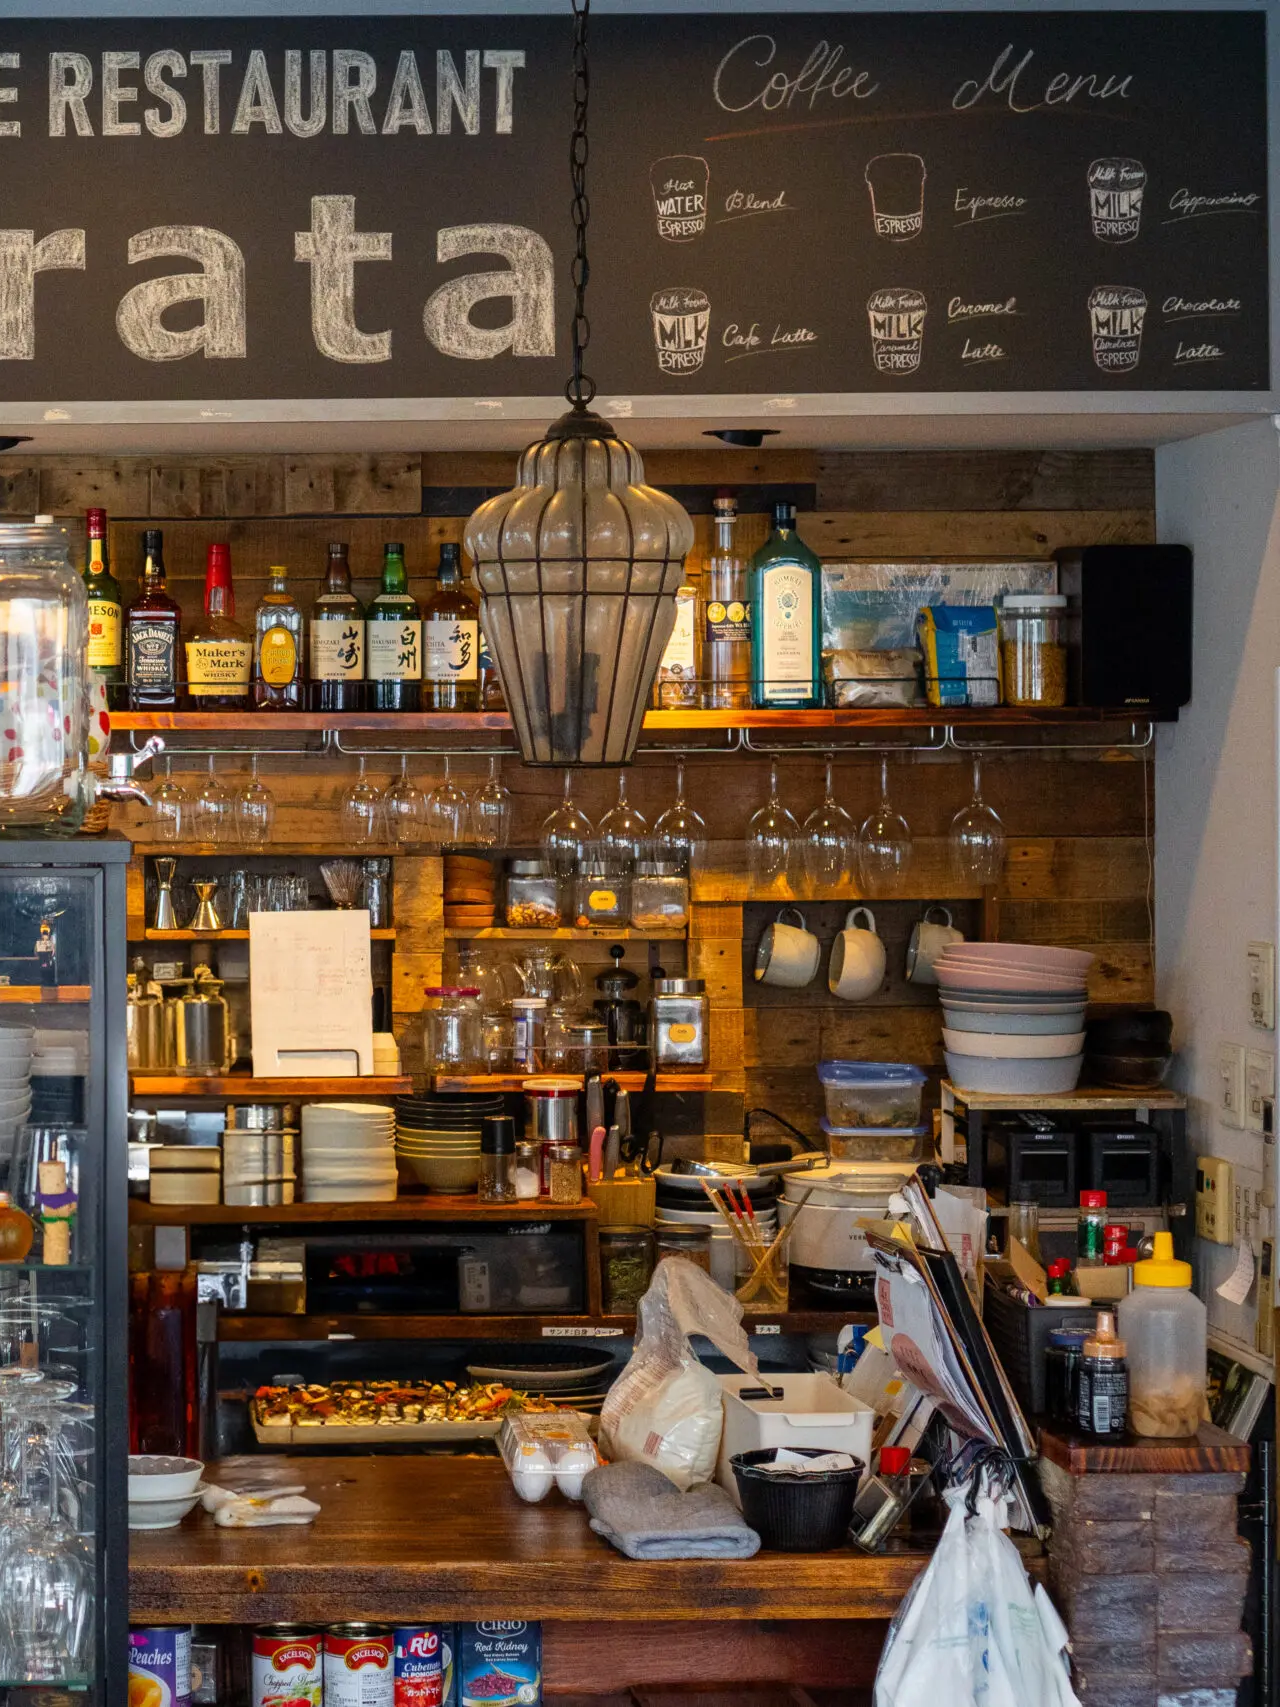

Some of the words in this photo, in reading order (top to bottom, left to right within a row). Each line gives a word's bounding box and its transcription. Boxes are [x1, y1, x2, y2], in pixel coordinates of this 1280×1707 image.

[713, 34, 880, 112] Coffee
[952, 43, 1133, 113] Menu
[48, 48, 526, 137] RESTAURANT
[656, 193, 705, 217] WATER
[725, 190, 787, 212] Blend
[1092, 190, 1143, 218] MILK
[658, 218, 704, 236] ESPRESSO
[877, 217, 921, 234] ESPRESSO
[1094, 218, 1139, 236] ESPRESSO
[948, 297, 1018, 316] Caramel
[657, 313, 707, 349] MILK
[870, 312, 924, 339] MILK
[1092, 307, 1144, 336] MILK
[770, 323, 818, 346] Latte
[961, 338, 1006, 360] Latte
[1096, 350, 1138, 367] ESPRESSO
[1176, 342, 1223, 359] Latte
[658, 350, 704, 369] ESPRESSO
[877, 352, 921, 369] ESPRESSO
[131, 630, 149, 644] JACK
[196, 648, 246, 658] Maker's
[336, 625, 361, 670] 山崎
[398, 625, 418, 672] 白州
[448, 624, 472, 671] 知多
[136, 665, 169, 673] WHISKEY
[210, 658, 245, 669] Mark
[481, 1620, 522, 1630] CIRIO
[131, 1648, 172, 1665] Peaches
[279, 1649, 313, 1663] EXCELSIOR
[351, 1650, 385, 1663] EXCELSIOR
[474, 1641, 493, 1653] Red
[495, 1641, 529, 1654] Kidney
[264, 1673, 293, 1692] Chopped
